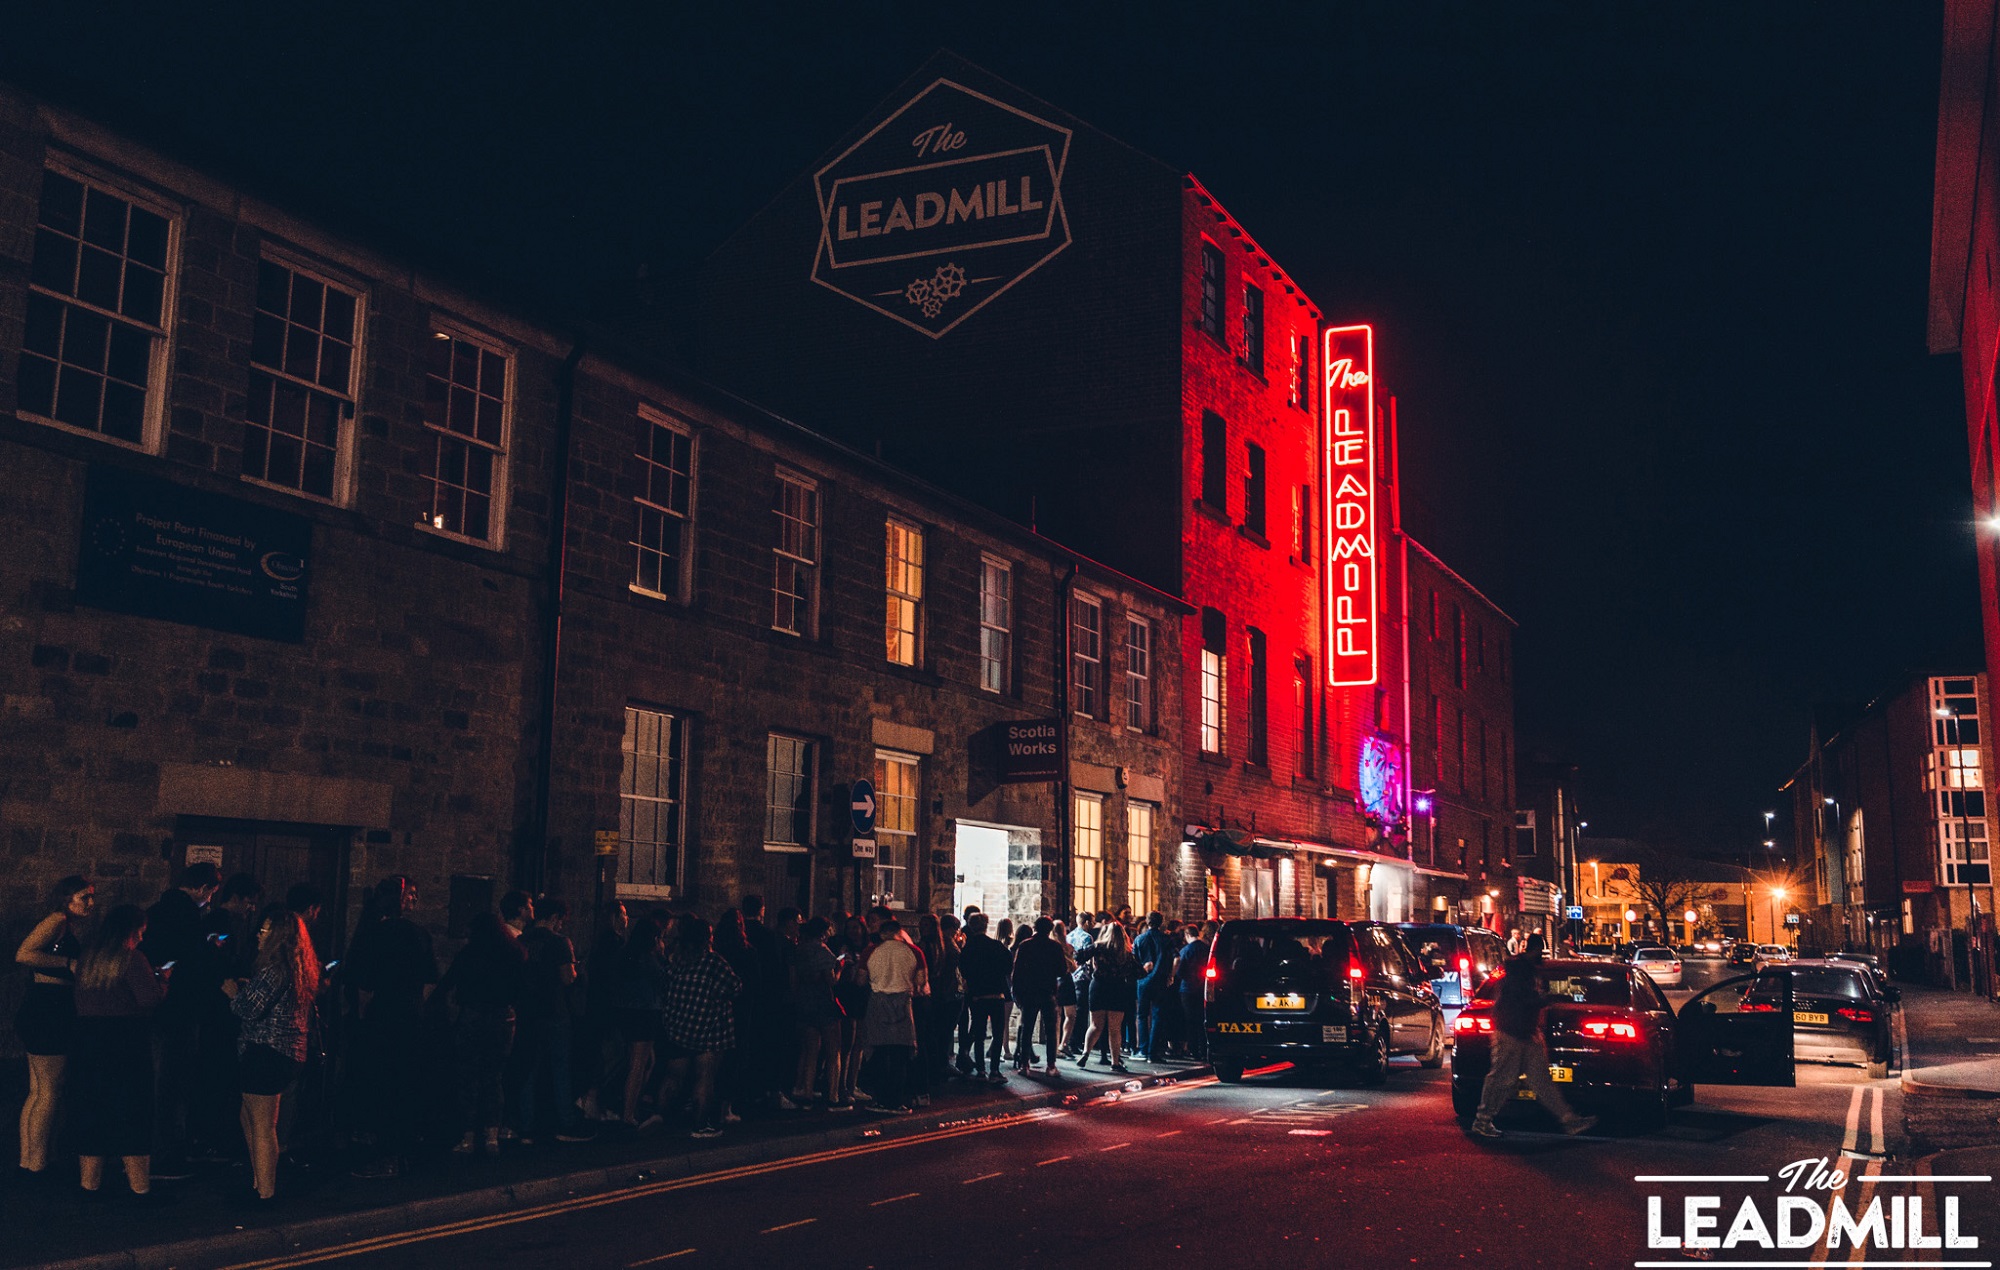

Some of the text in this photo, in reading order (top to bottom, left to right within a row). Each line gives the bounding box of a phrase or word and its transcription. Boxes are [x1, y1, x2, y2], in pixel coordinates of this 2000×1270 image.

[912, 121, 968, 158] The
[837, 175, 1044, 241] LEADMILL
[1329, 357, 1369, 389] The
[135, 512, 257, 551] Project Part Financed by
[1331, 408, 1373, 657] LEADMILL
[156, 533, 236, 560] European Union
[1008, 724, 1056, 739] Scotia
[1008, 741, 1057, 756] Works
[854, 843, 874, 855] One way
[1217, 1022, 1263, 1034] TAXI
